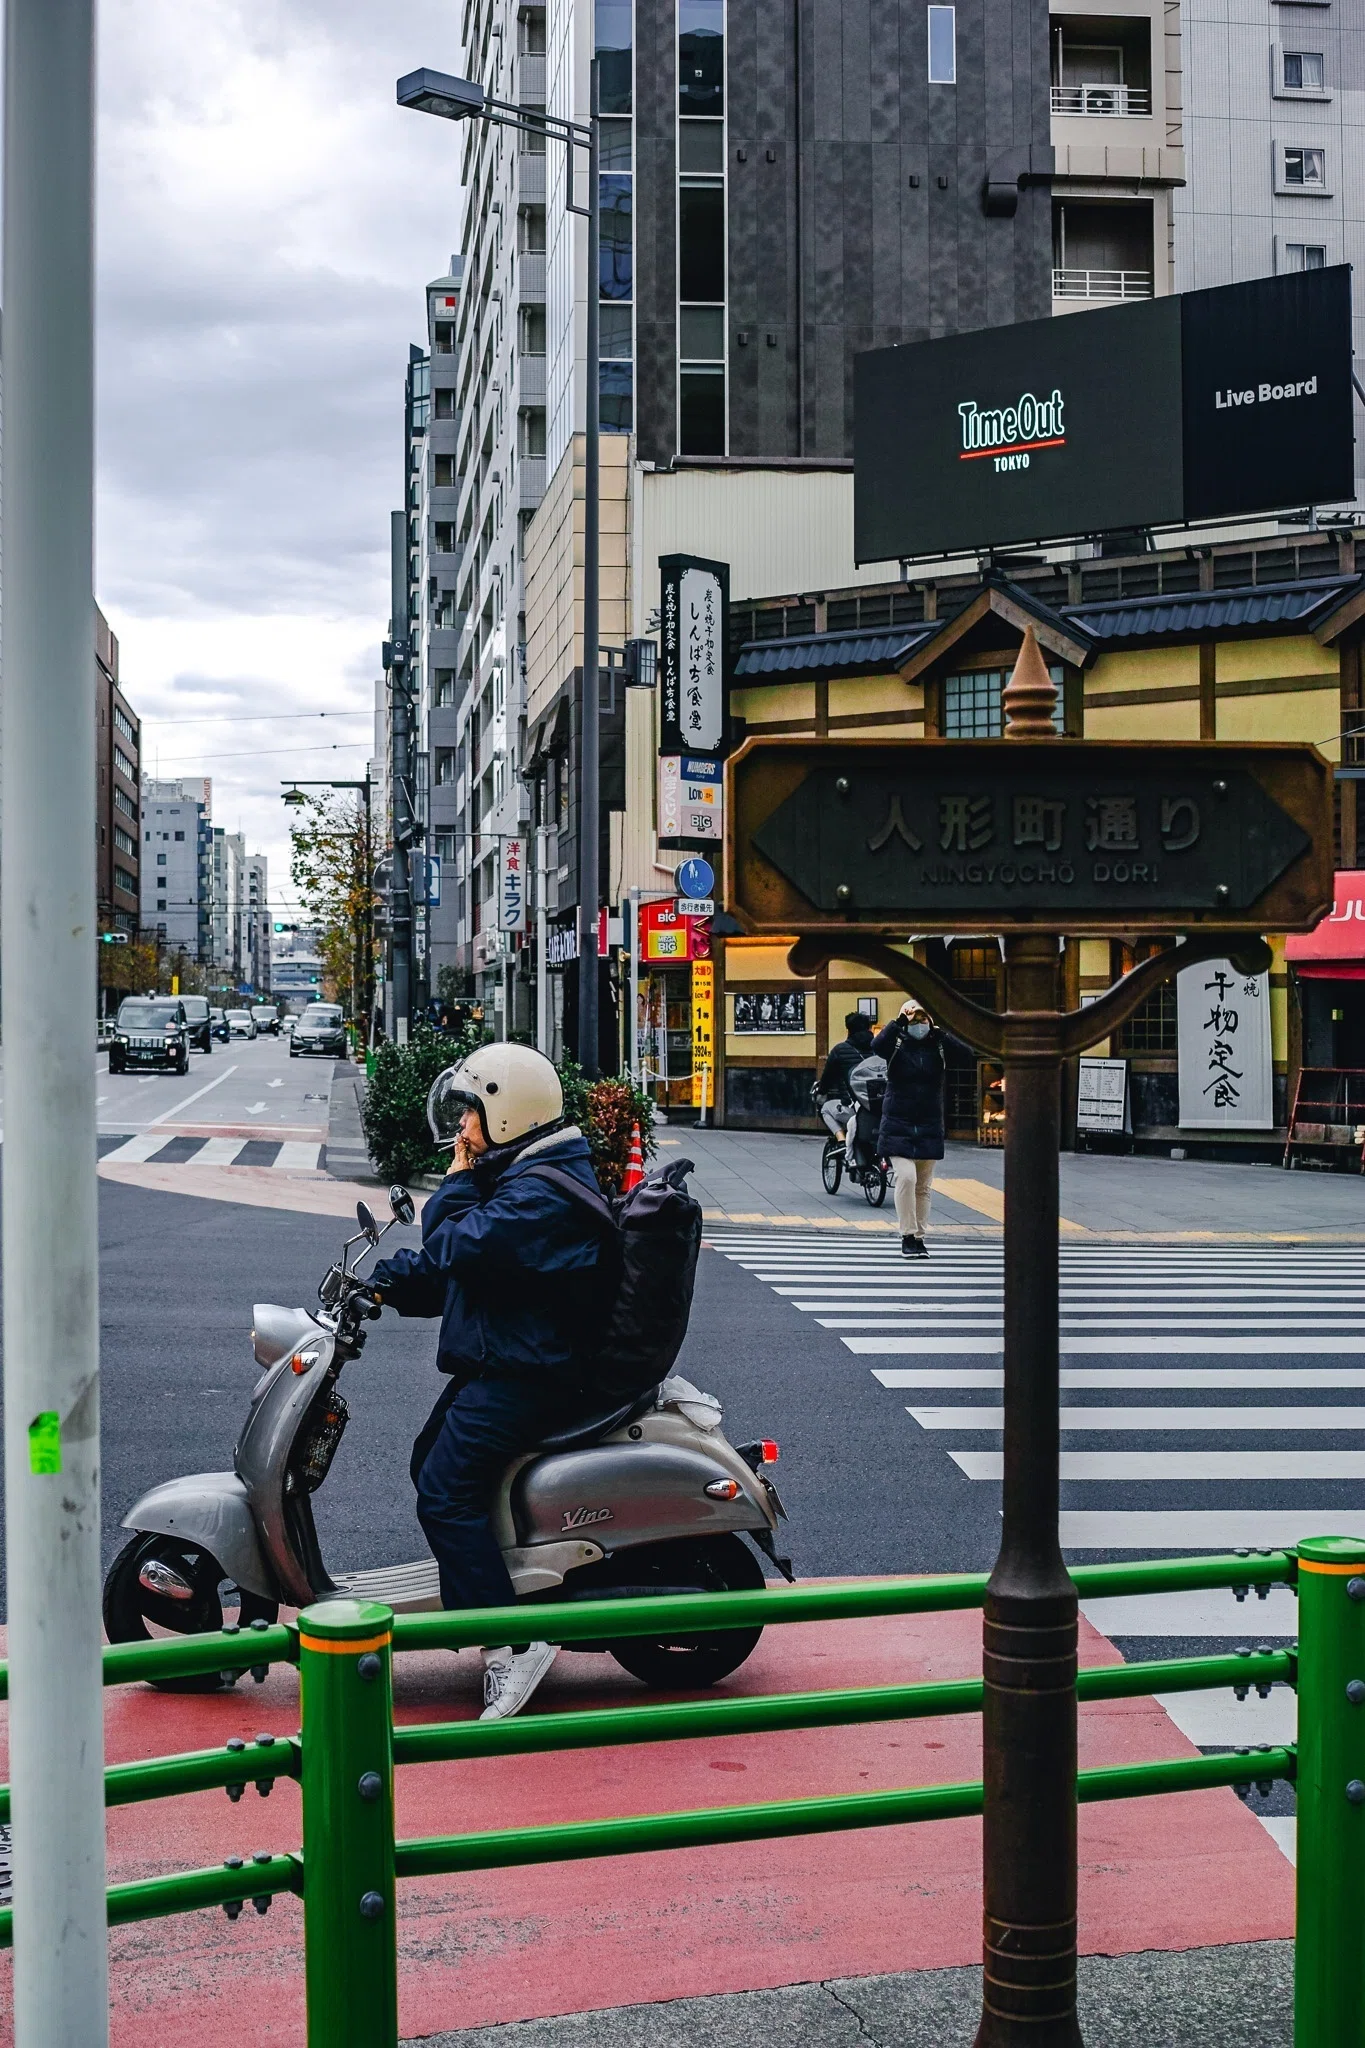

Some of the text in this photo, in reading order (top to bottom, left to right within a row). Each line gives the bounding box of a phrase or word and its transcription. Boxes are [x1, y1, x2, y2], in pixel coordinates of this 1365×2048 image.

[1215, 376, 1317, 409] Live Board
[958, 389, 1065, 450] Time Out
[993, 453, 1030, 473] TOKYO
[687, 602, 703, 731] しんぱち食堂
[690, 814, 712, 829] BIG
[866, 794, 1201, 853] 人形町通り
[657, 911, 677, 923] BIG
[680, 902, 713, 913] 歩行者優先
[657, 942, 678, 952] BIG
[1203, 971, 1244, 1108] 干物定食
[561, 1506, 614, 1532] Vino
